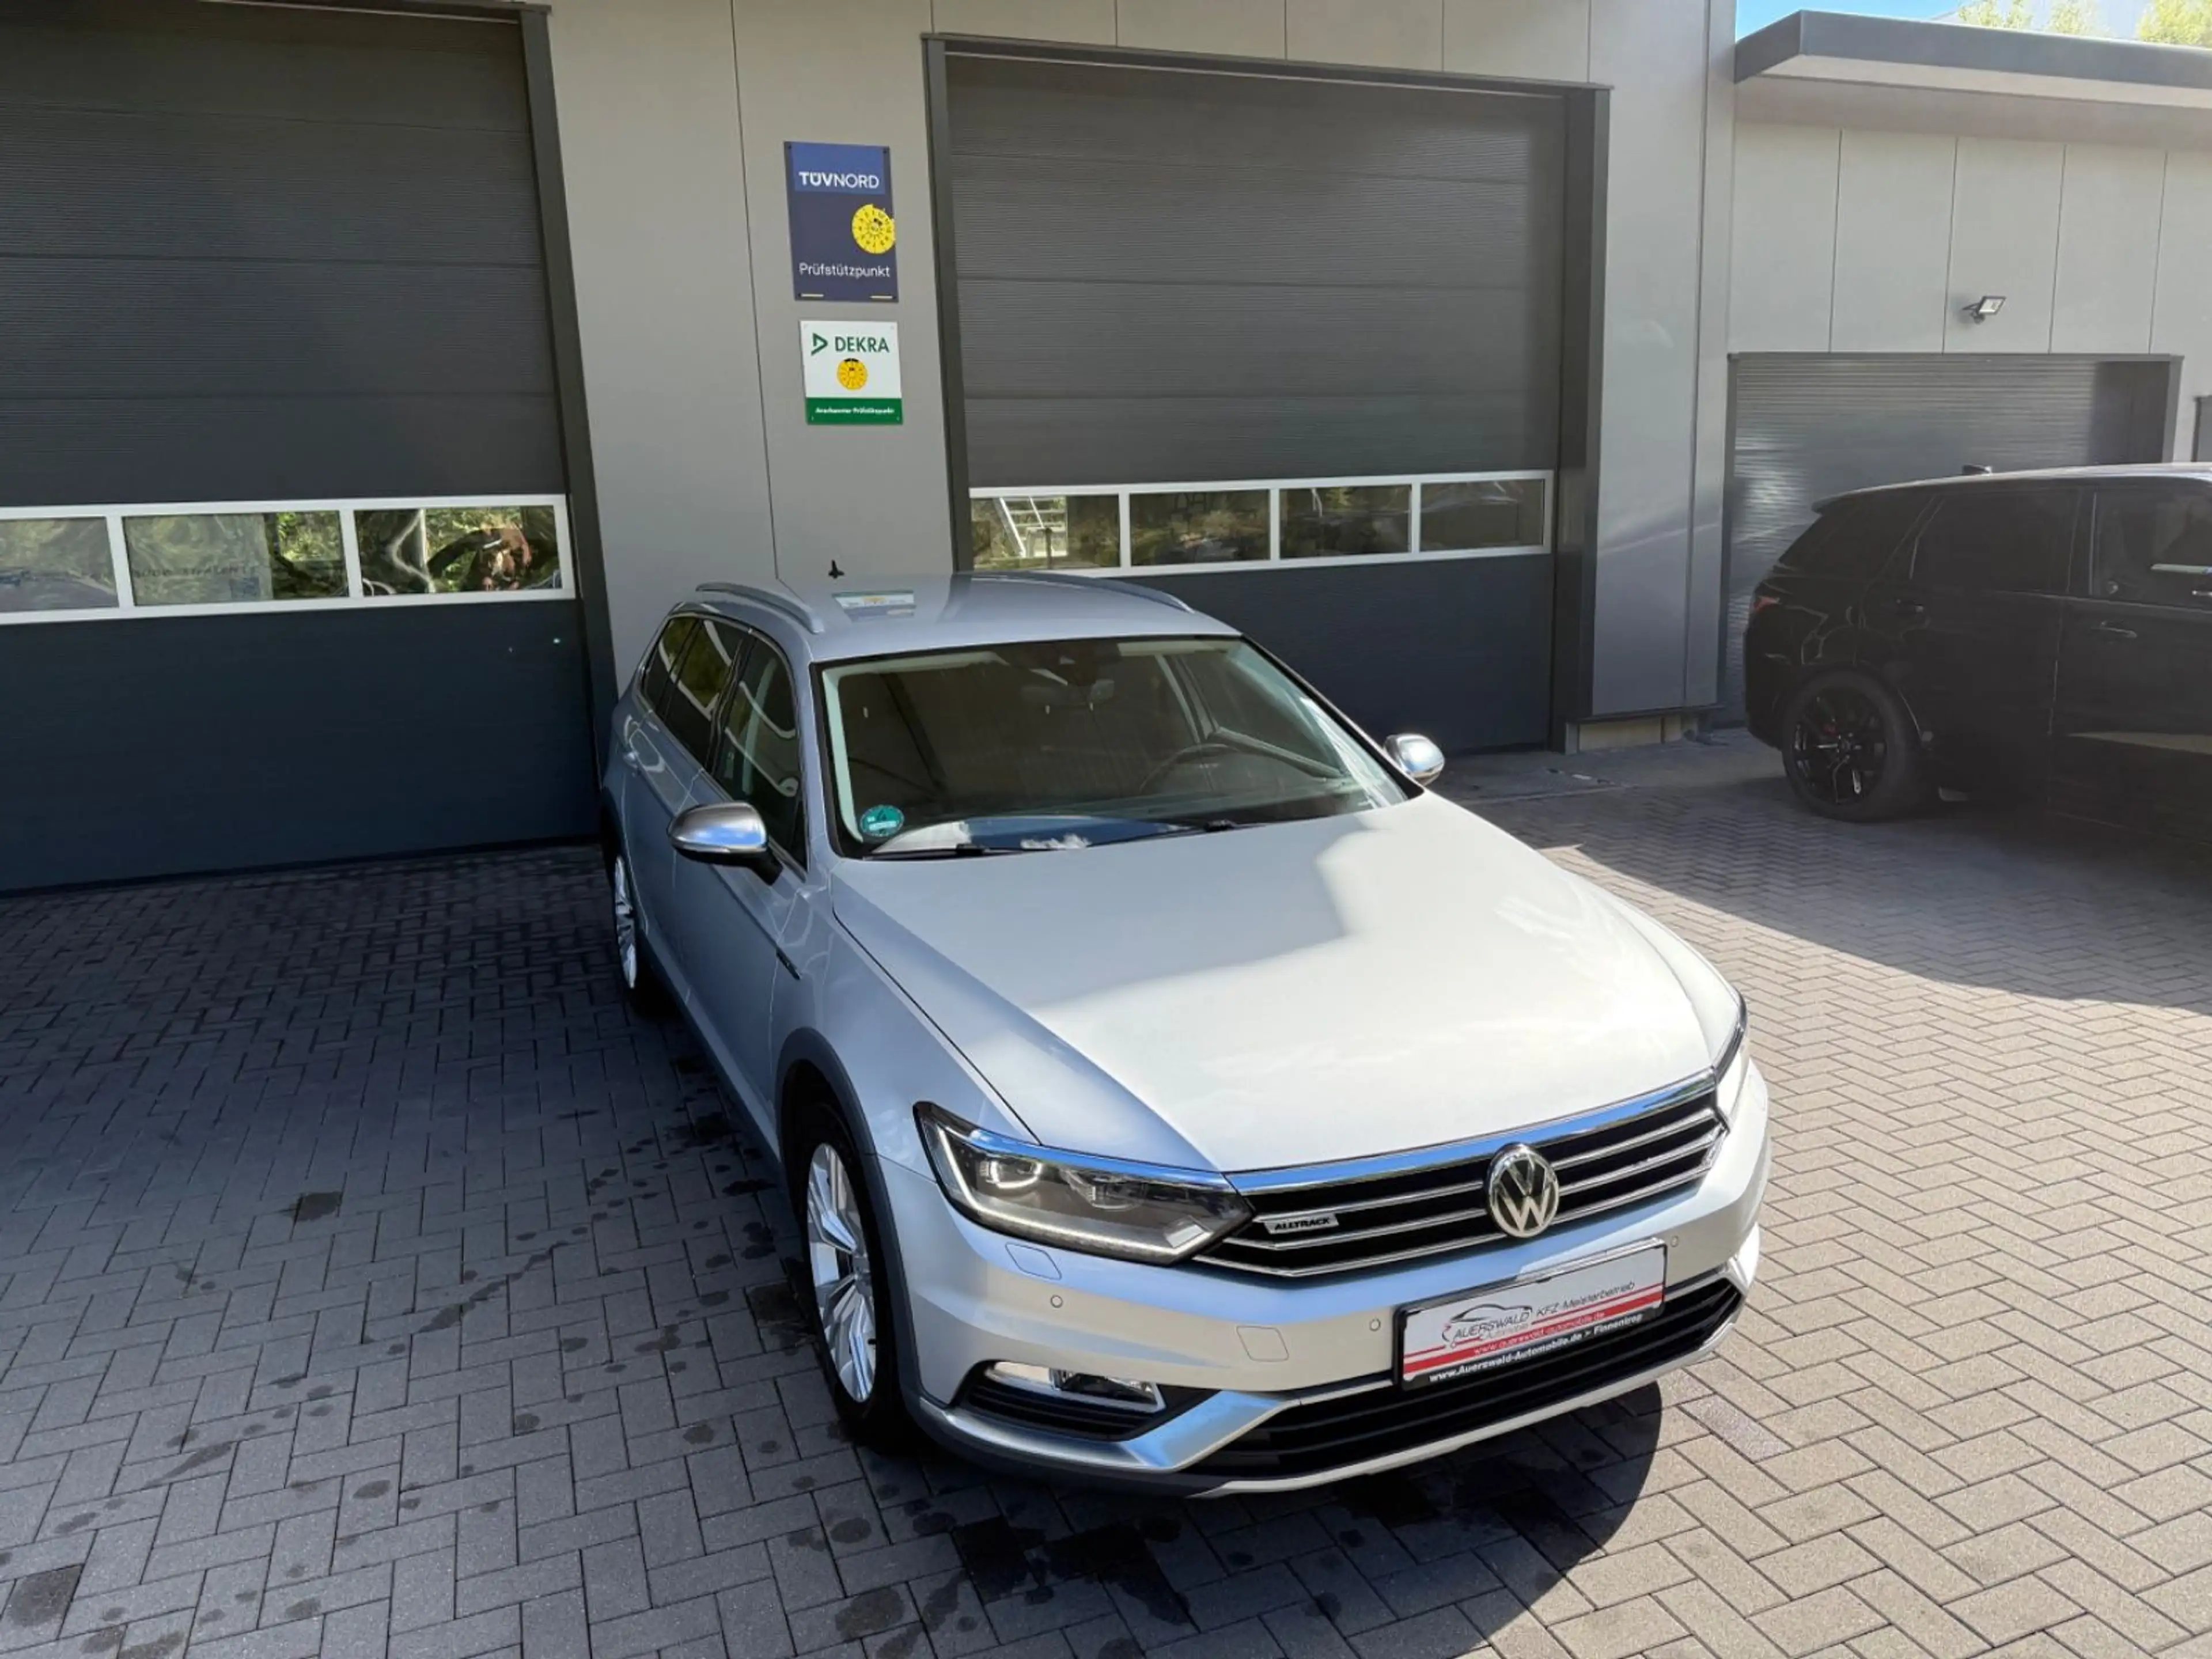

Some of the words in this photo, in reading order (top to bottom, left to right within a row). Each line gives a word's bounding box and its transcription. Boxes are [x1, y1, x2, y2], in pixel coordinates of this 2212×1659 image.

[798, 262, 891, 279] Prüfstützpunkt
[835, 336, 890, 353] DEKRA
[1274, 1216, 1330, 1231] ALLTRACK
